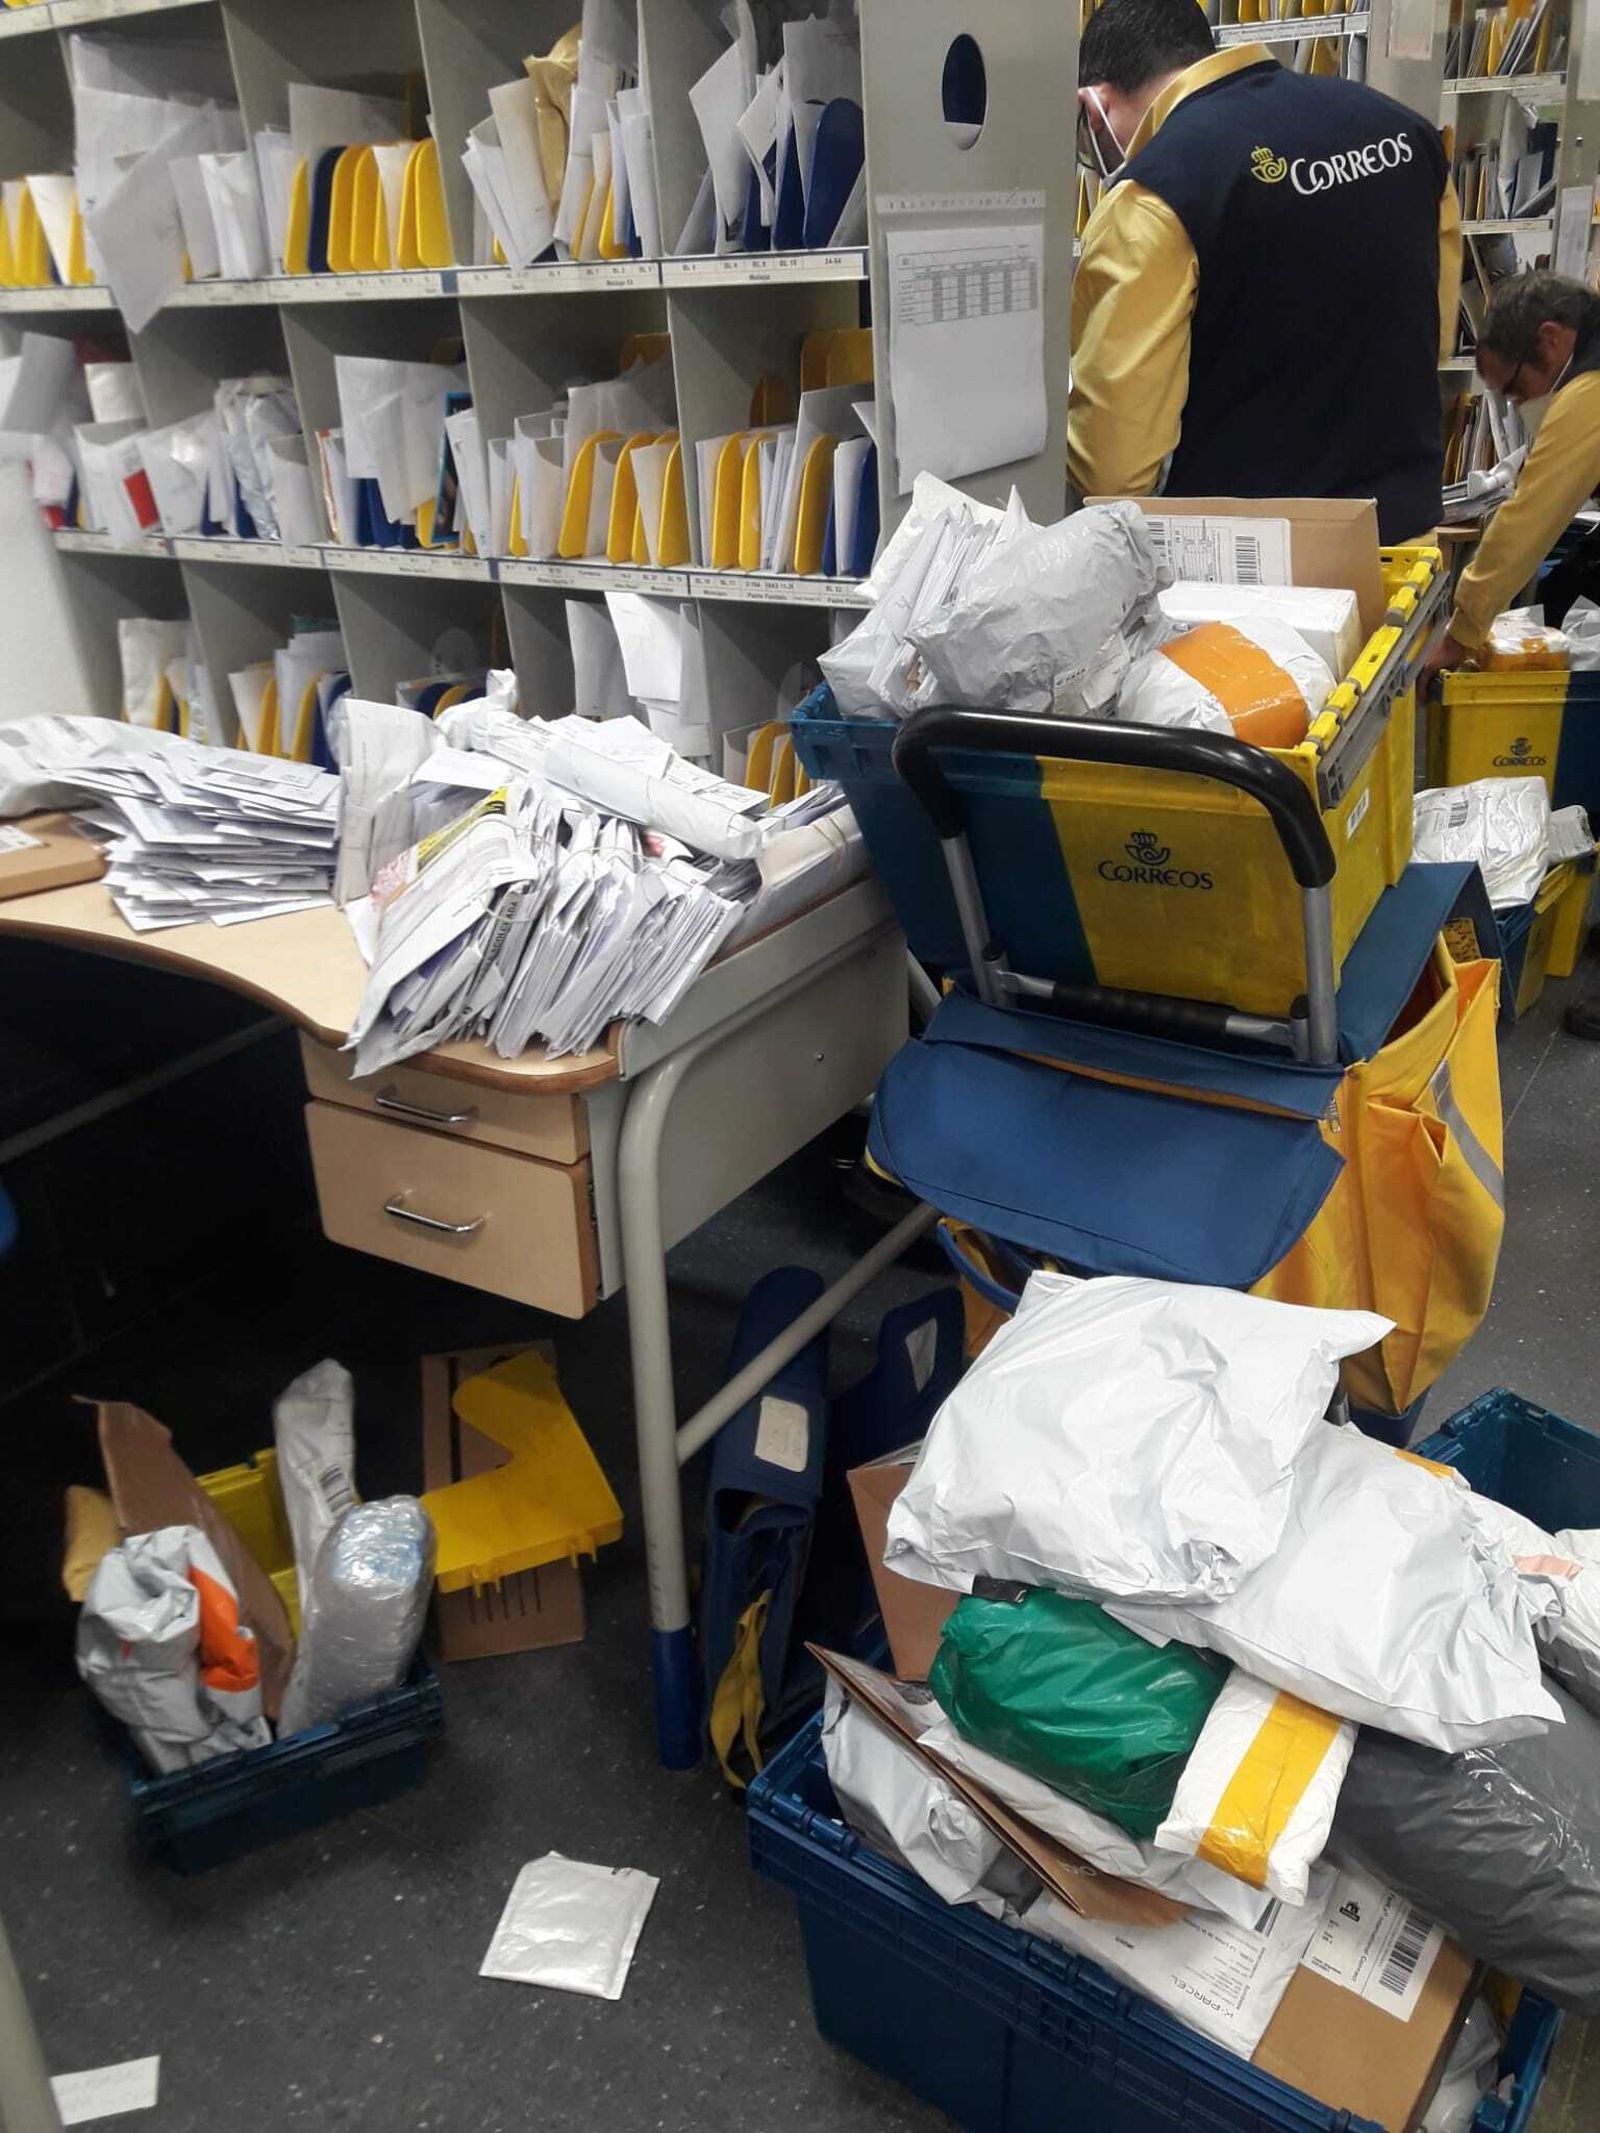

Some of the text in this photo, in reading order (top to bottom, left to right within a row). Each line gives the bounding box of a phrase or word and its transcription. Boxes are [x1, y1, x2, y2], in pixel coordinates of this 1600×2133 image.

[1290, 132, 1413, 195] CORREOS
[1493, 755, 1547, 767] CORREOS
[1098, 860, 1214, 890] CORREOS
[1171, 1974, 1234, 2018] K-PARCEL
